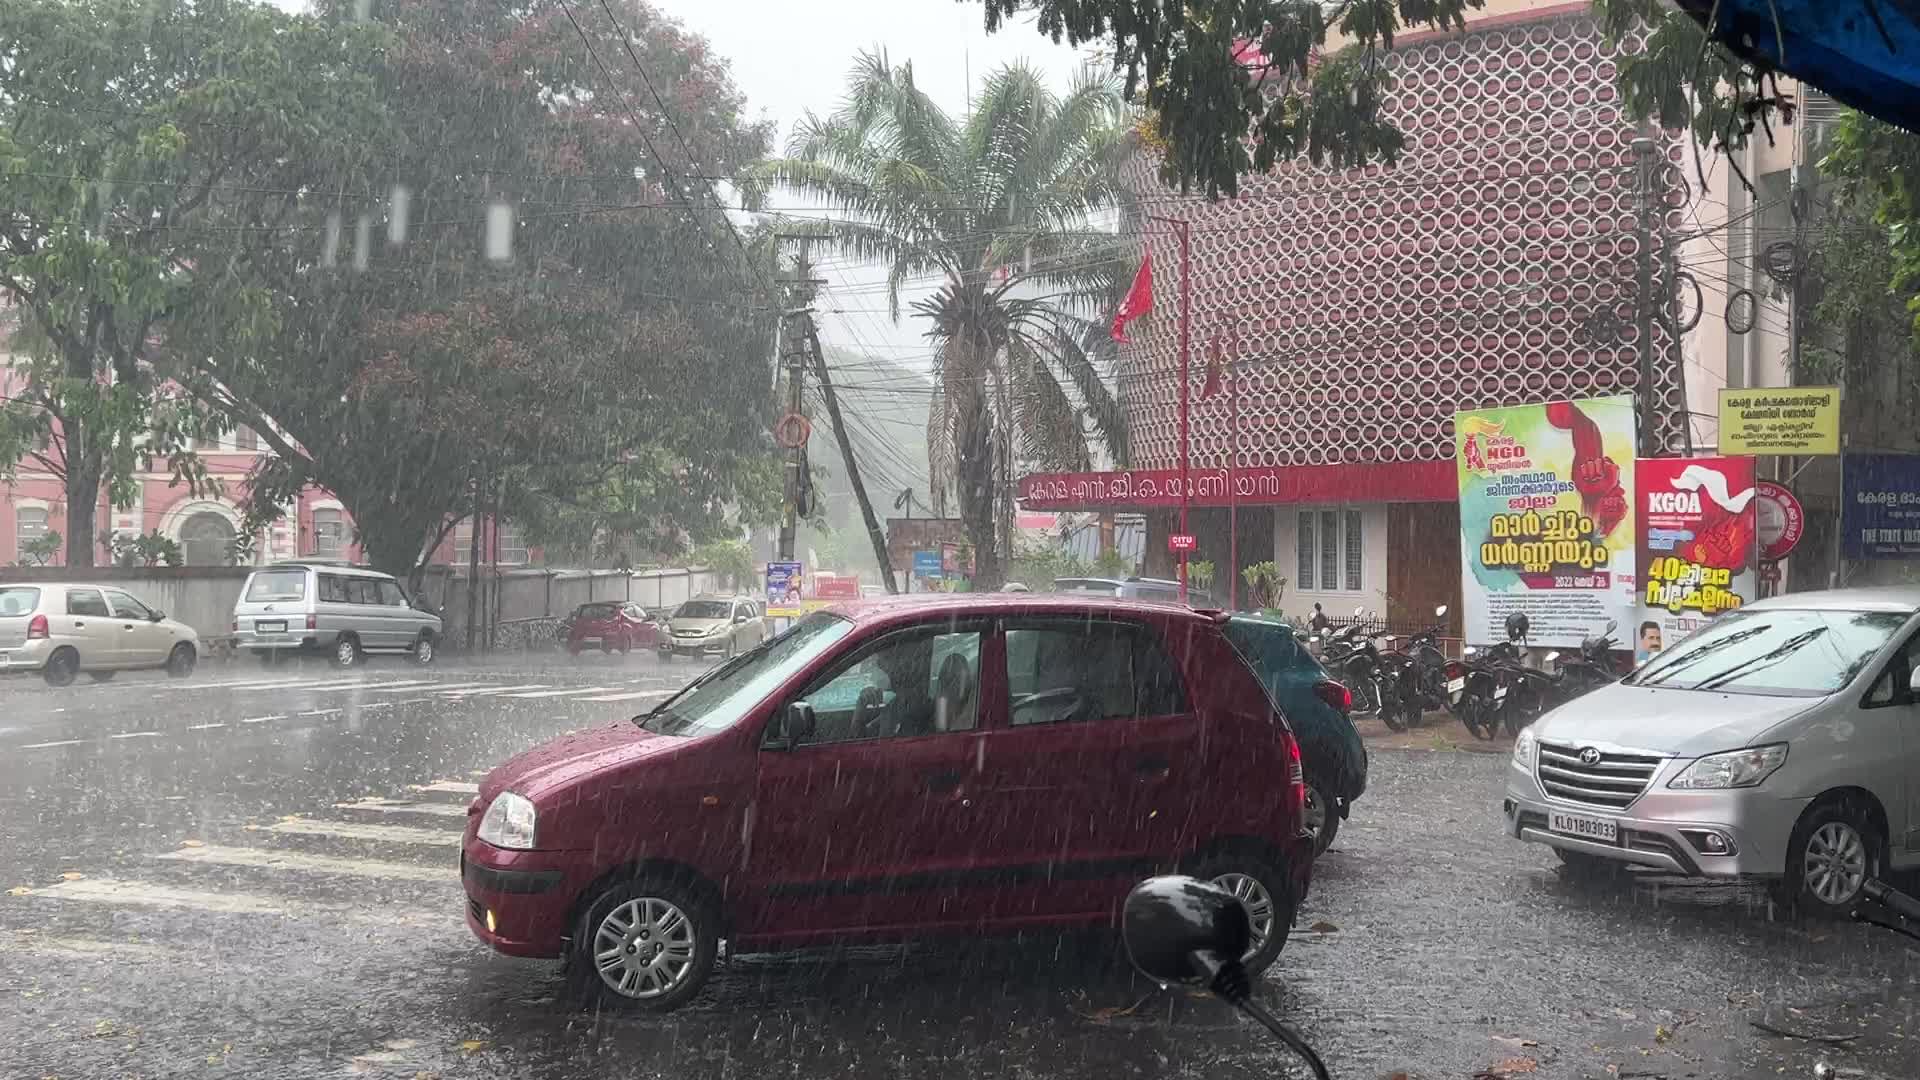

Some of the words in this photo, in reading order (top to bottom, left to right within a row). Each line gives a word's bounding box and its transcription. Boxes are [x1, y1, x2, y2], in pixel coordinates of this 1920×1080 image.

[1487, 446, 1526, 459] NGO
[1029, 481, 1068, 500] കേരള
[1857, 491, 1897, 507] കേരള
[1508, 496, 1557, 509] ജില്ലാ
[1648, 492, 1702, 513] KGOA
[1491, 509, 1594, 541] മാർച്ചും
